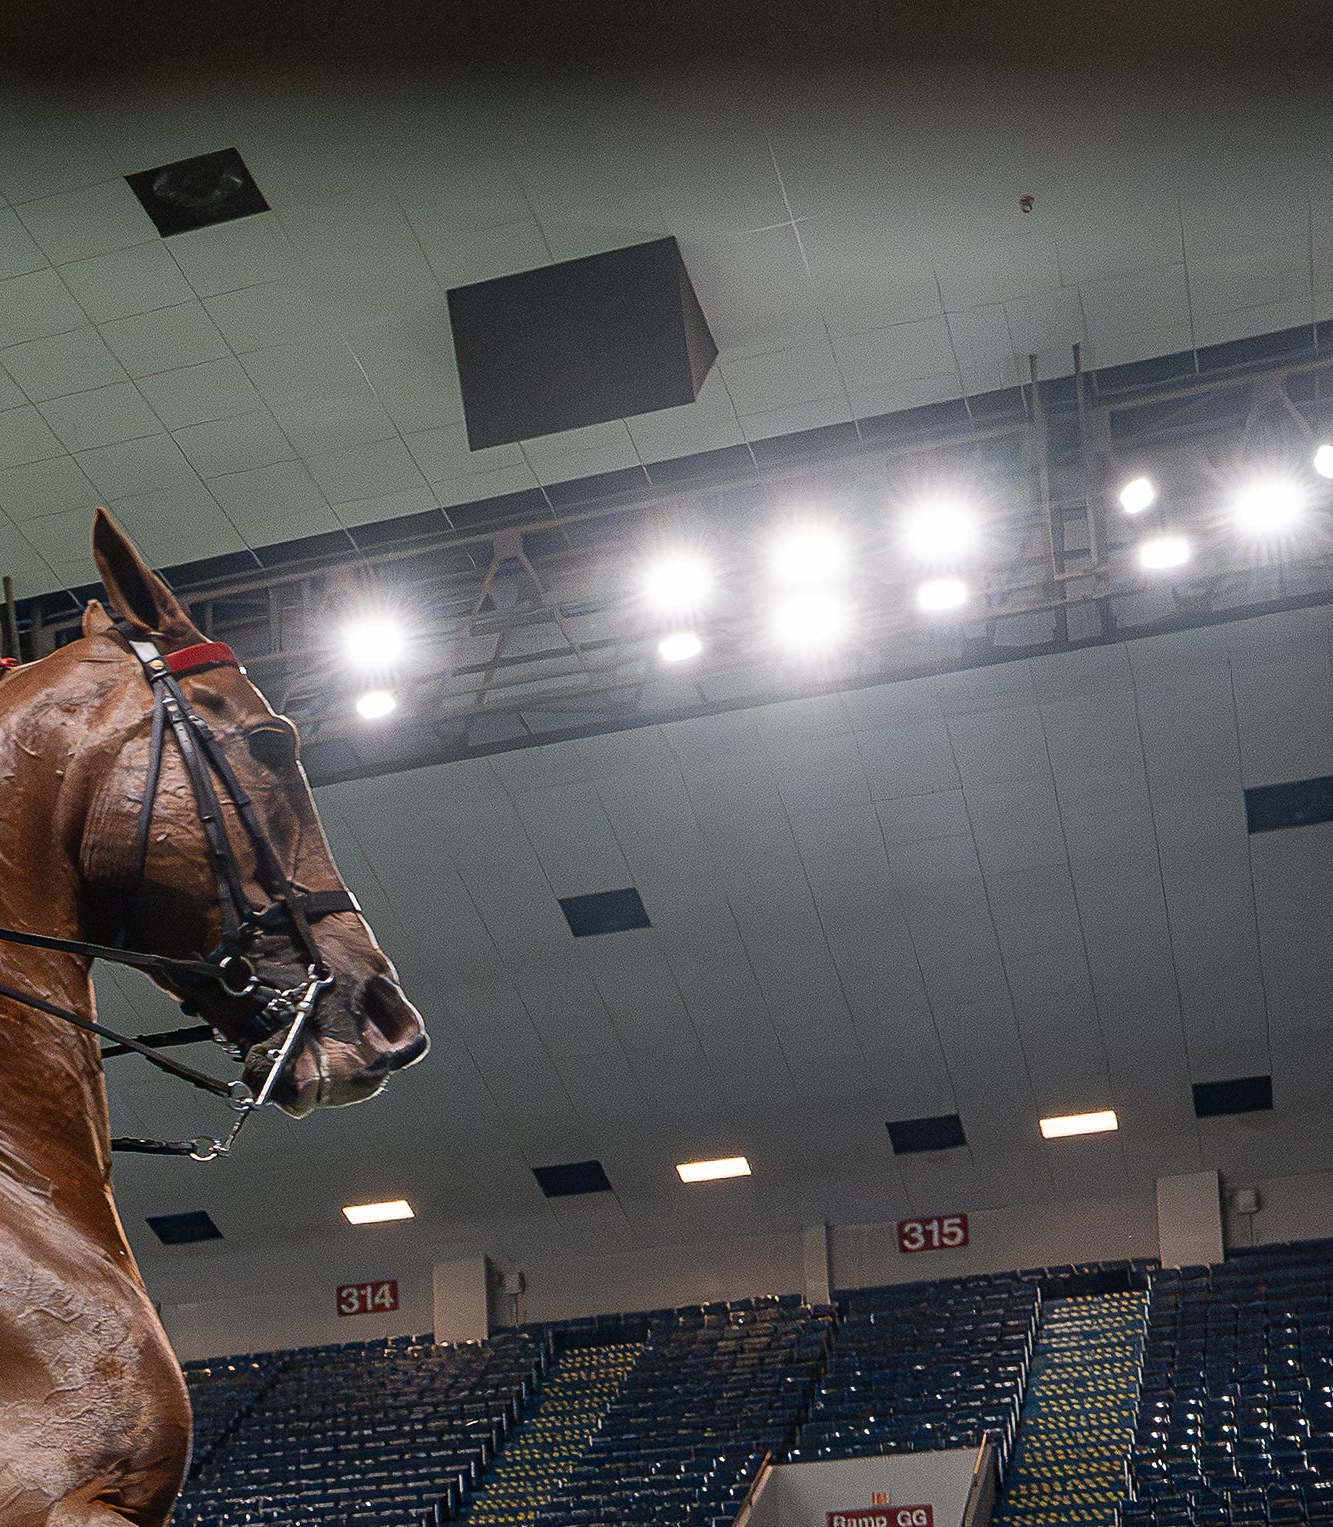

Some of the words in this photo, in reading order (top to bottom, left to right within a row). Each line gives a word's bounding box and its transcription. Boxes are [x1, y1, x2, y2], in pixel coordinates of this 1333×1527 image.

[902, 1217, 964, 1250] 315
[340, 1283, 394, 1313] 314
[897, 1508, 928, 1527] GG
